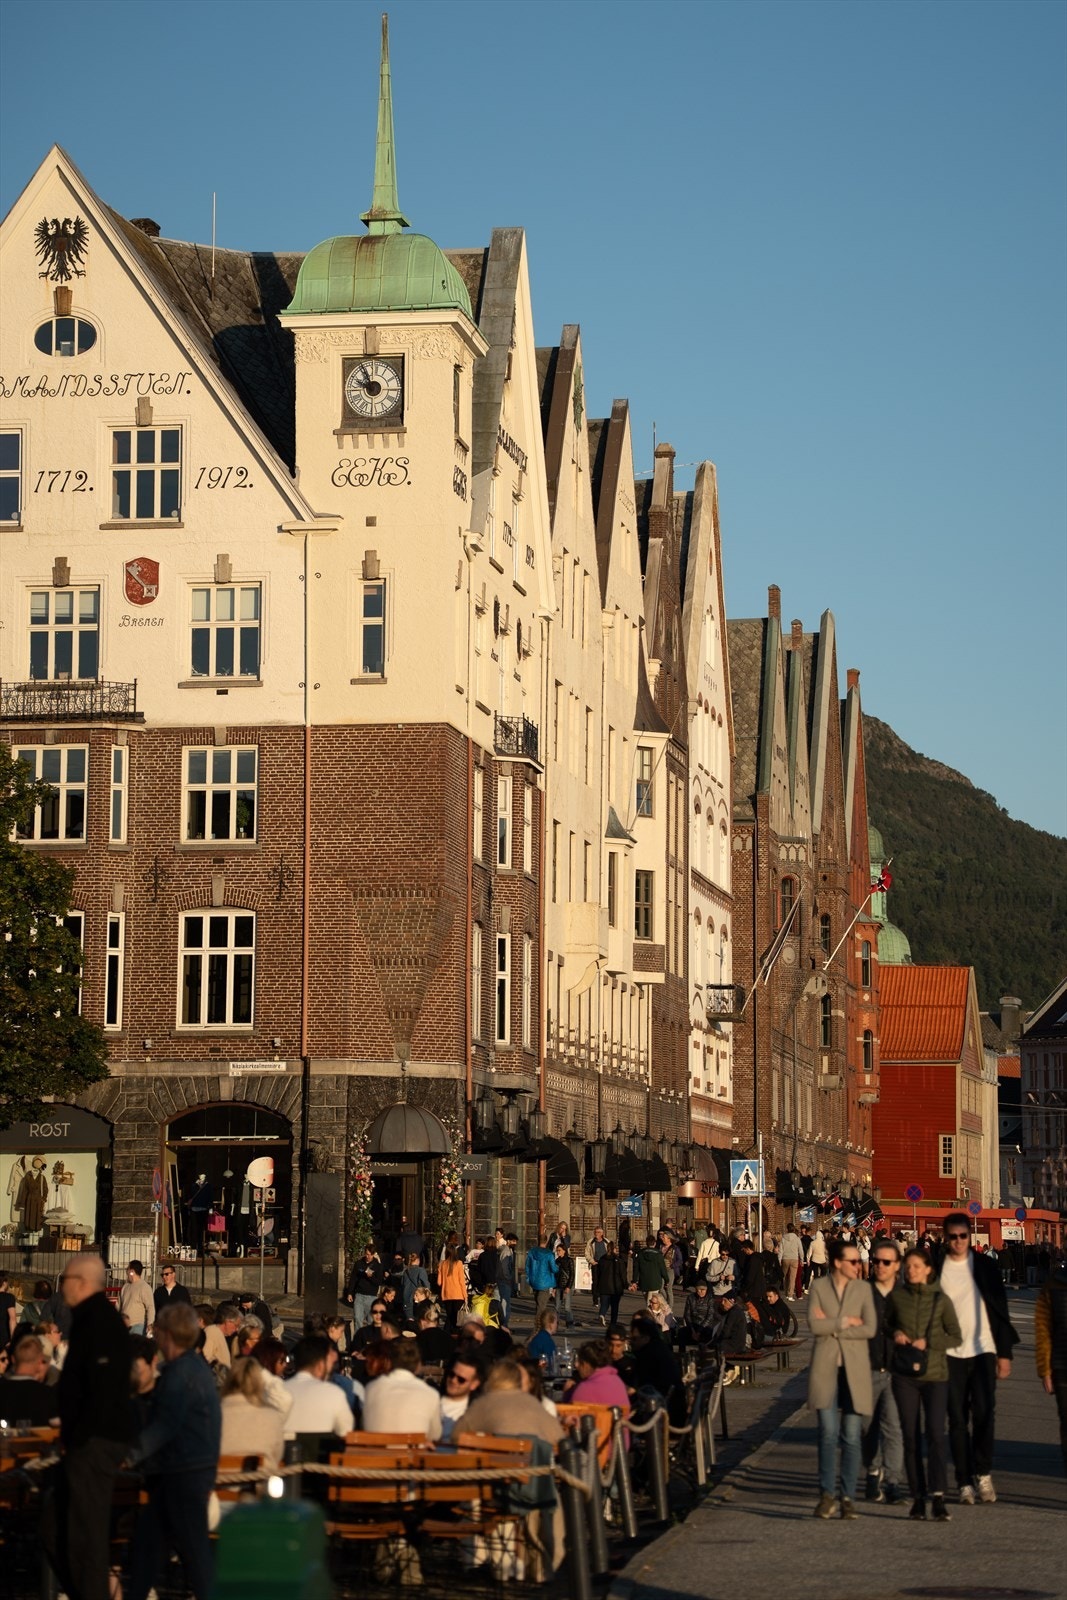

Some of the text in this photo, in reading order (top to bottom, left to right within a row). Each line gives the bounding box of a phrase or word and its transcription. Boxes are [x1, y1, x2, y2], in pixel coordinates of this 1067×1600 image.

[34, 466, 254, 493] 1712. 1912.
[30, 1122, 71, 1137] RØST
